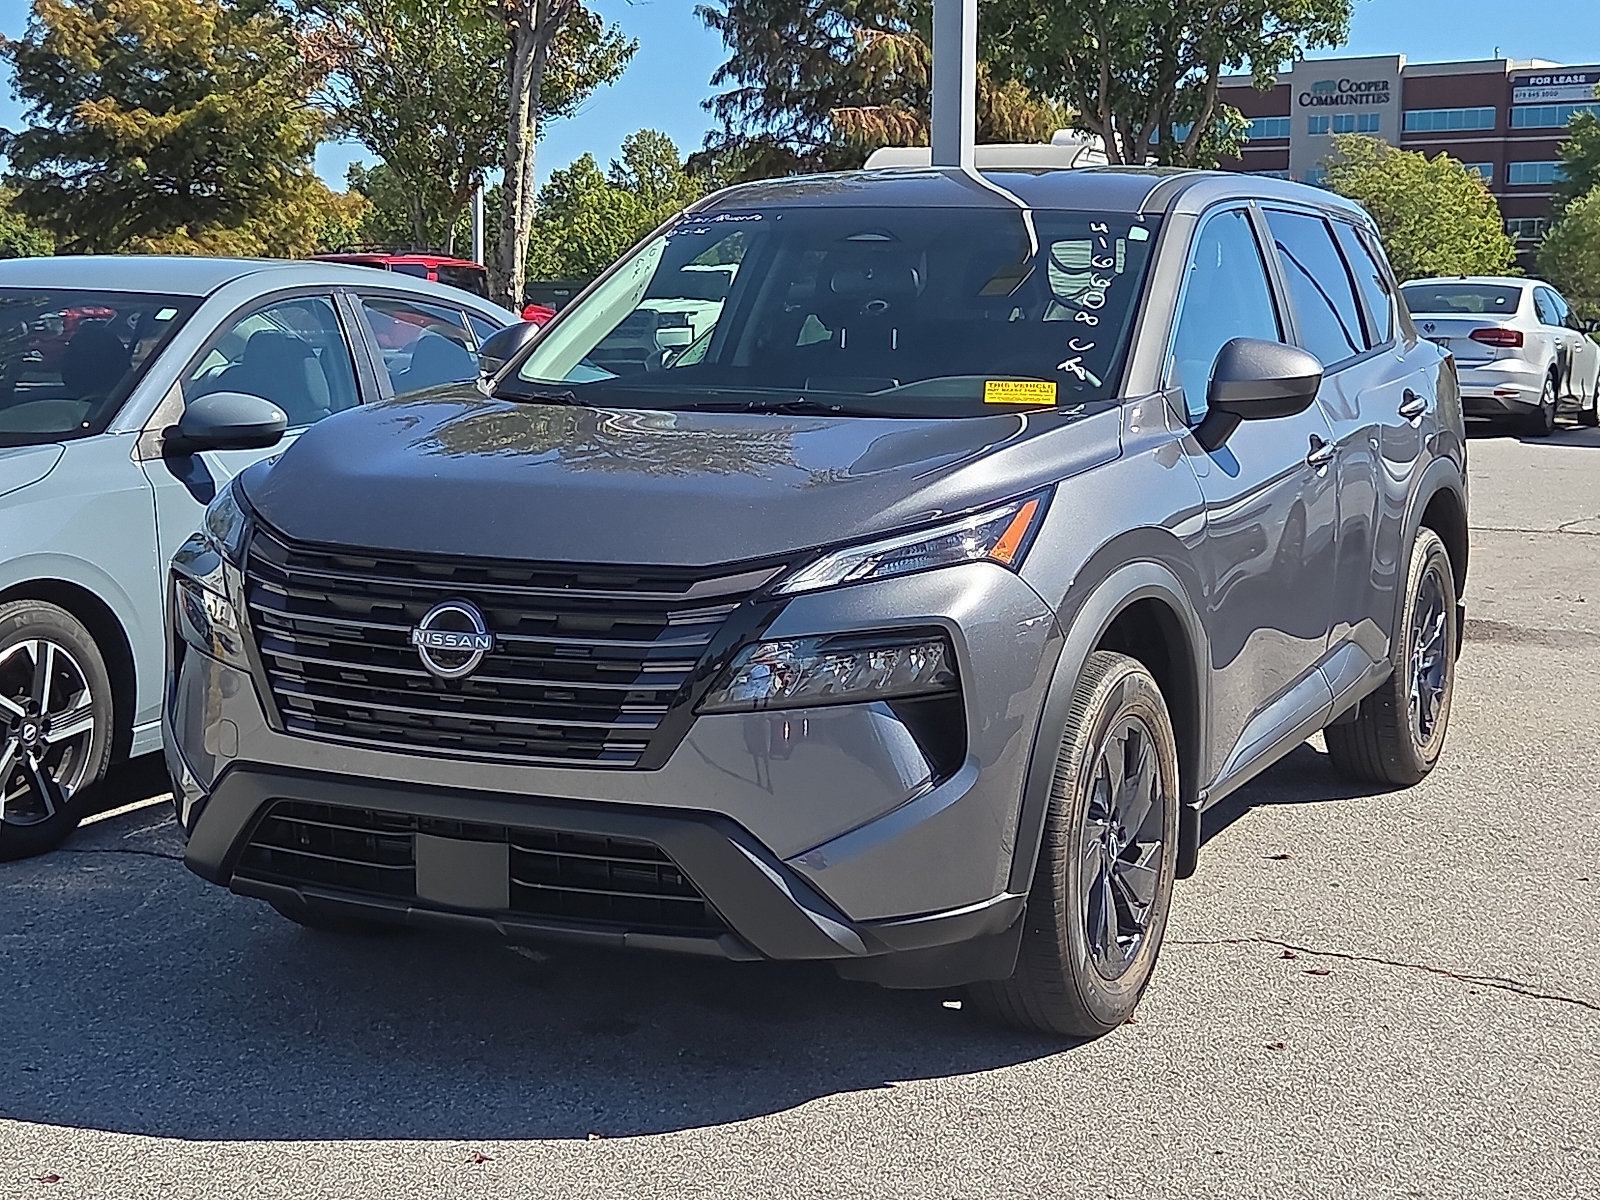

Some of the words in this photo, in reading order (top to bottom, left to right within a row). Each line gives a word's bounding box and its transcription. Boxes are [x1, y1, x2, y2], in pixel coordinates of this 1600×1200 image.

[1337, 78, 1389, 93] COOPER
[1529, 77, 1551, 86] FOR
[1552, 75, 1586, 85] LEASE
[1298, 92, 1390, 107] COMMUNITIES
[413, 630, 489, 649] NISSAN
